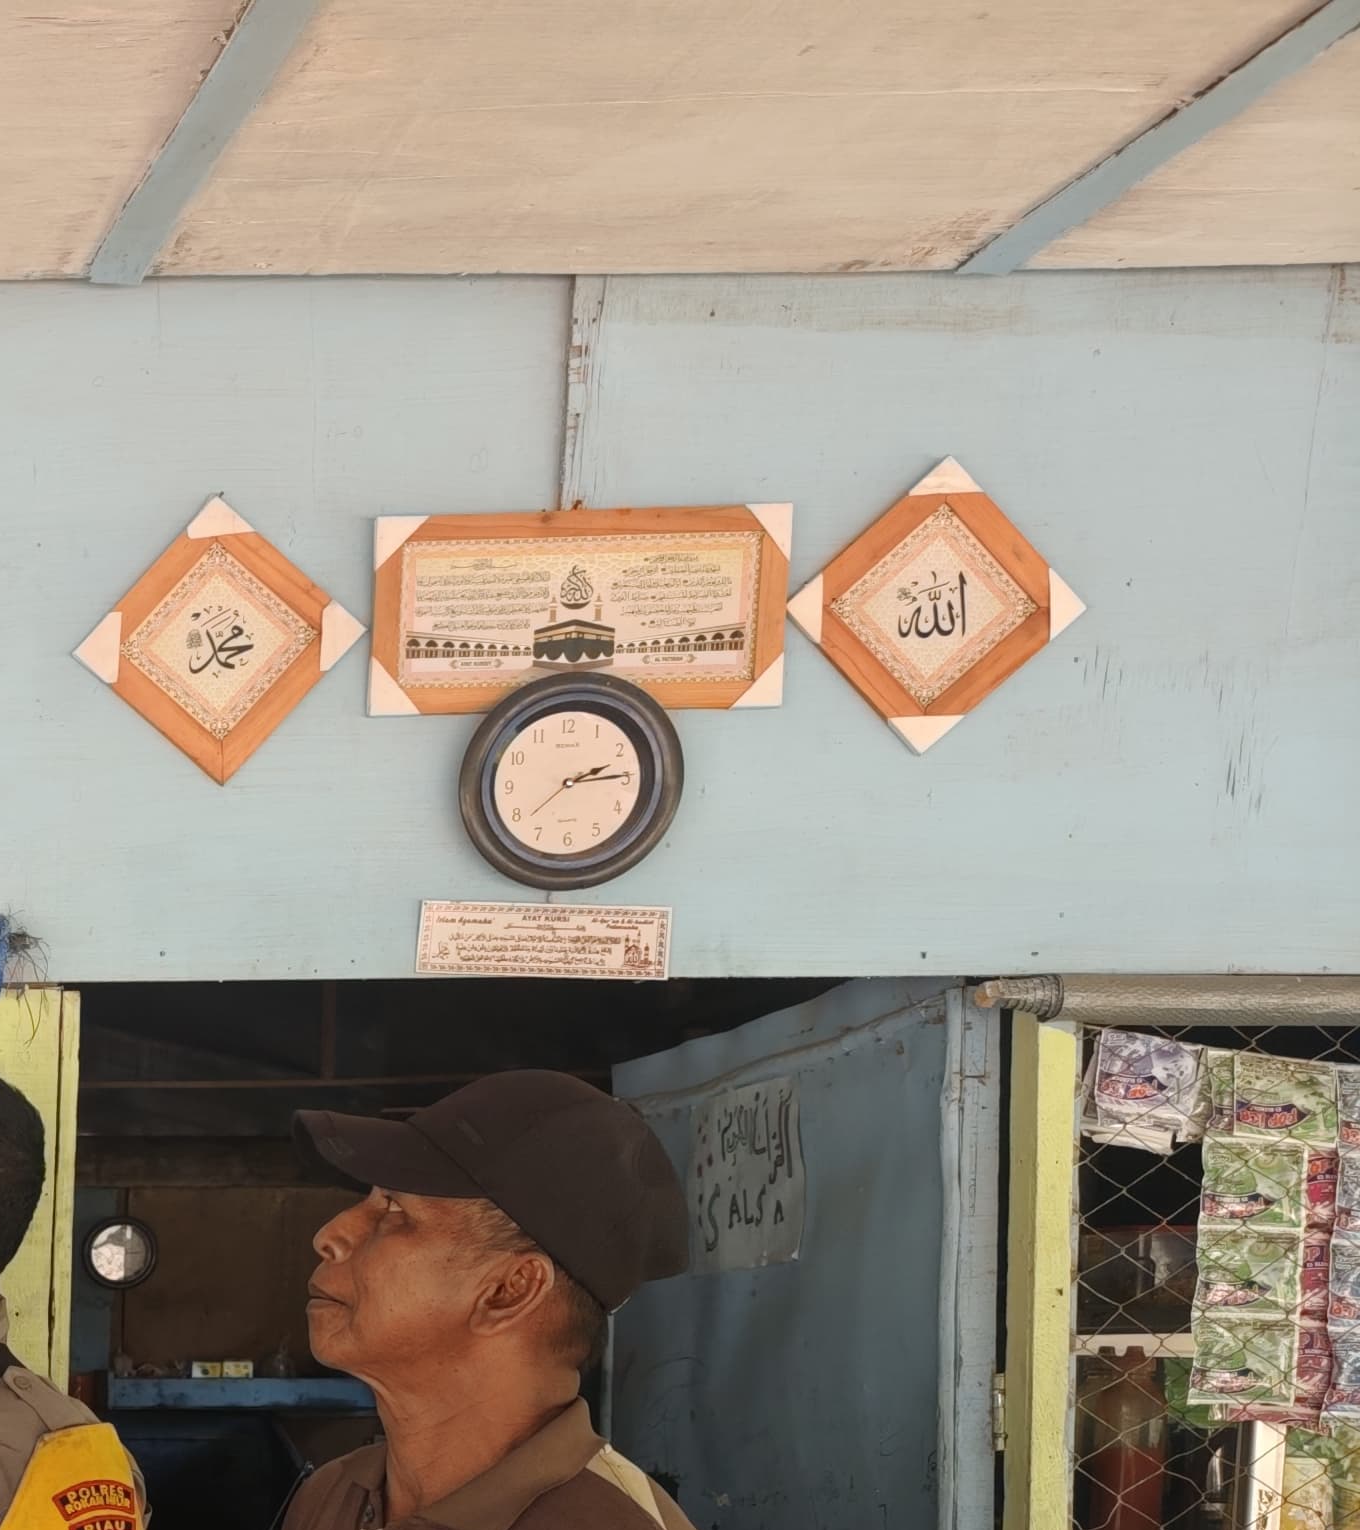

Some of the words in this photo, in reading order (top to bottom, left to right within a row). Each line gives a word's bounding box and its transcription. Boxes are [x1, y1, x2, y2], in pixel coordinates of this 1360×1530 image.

[562, 719, 575, 734] 12
[594, 724, 600, 739] 1
[533, 729, 545, 743] 11
[615, 743, 624, 757] 2
[511, 751, 525, 765] 10
[504, 780, 514, 795] 9
[613, 800, 622, 814] 4
[512, 808, 522, 822] 8
[534, 827, 543, 841] 7
[592, 823, 600, 837] 5
[563, 832, 572, 846] 6
[66, 1484, 125, 1503] POLRES
